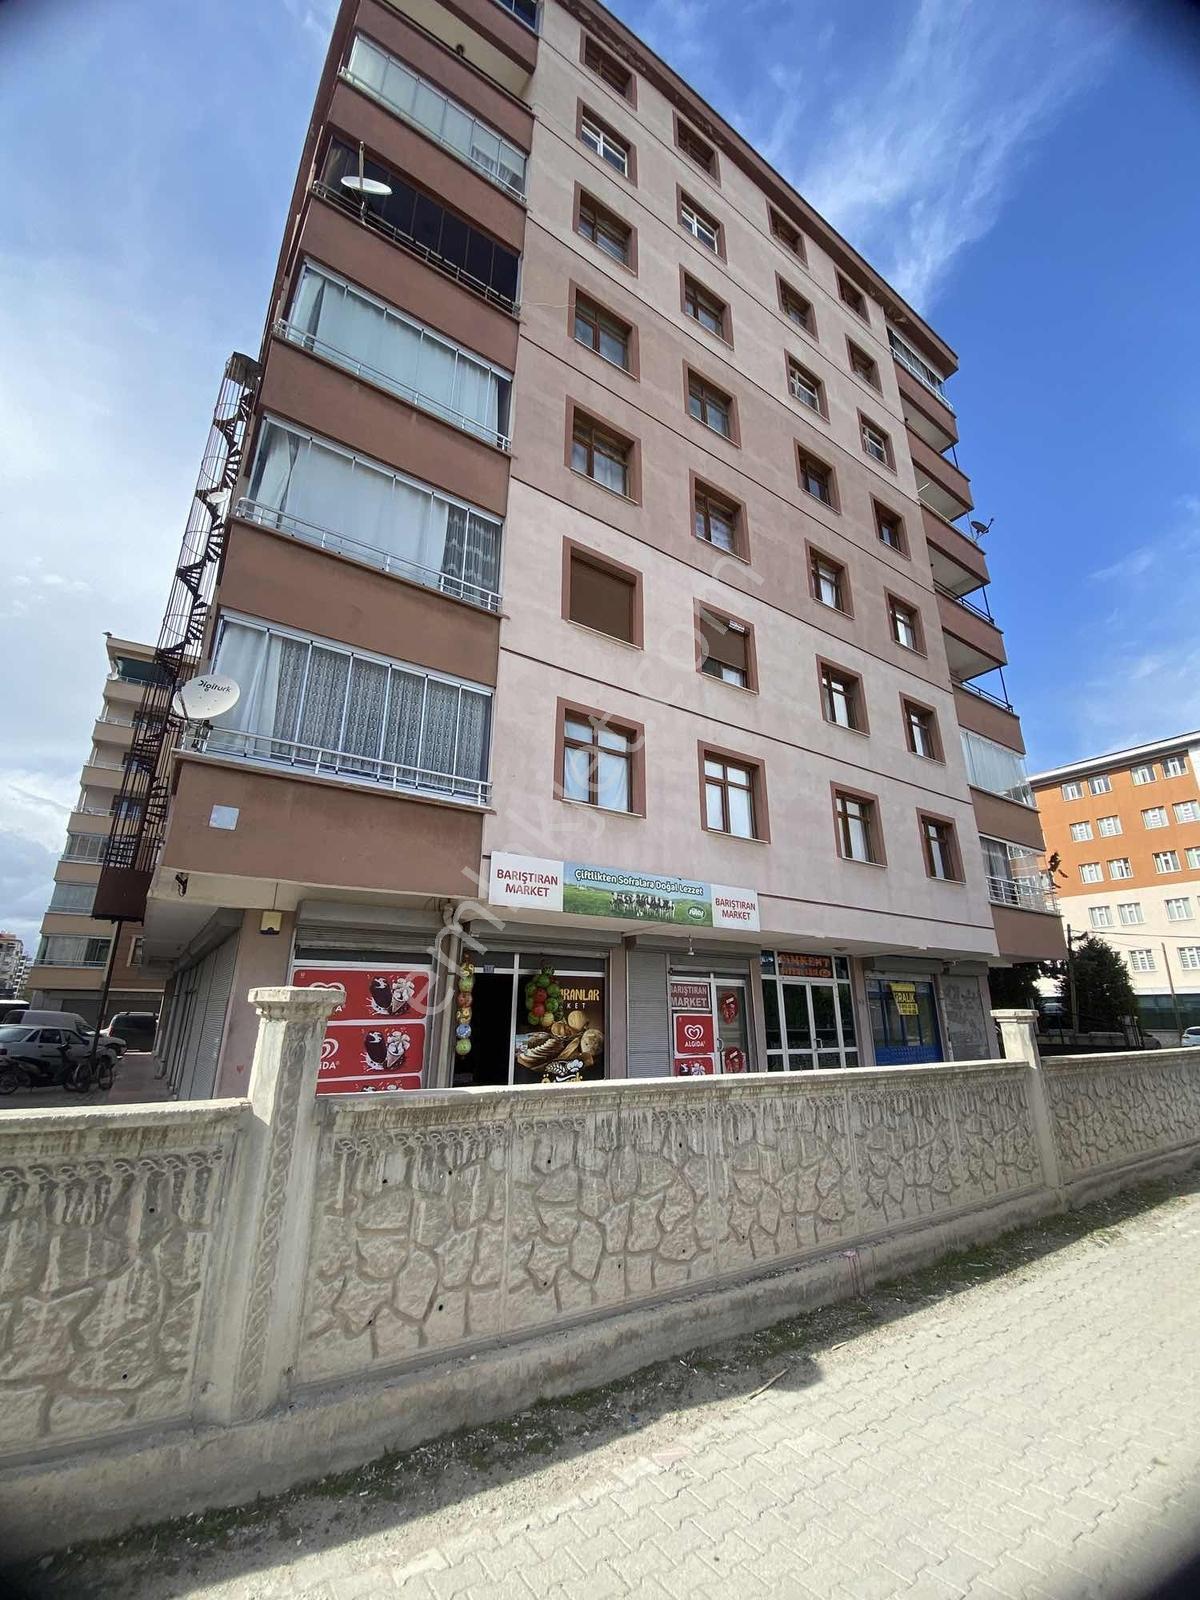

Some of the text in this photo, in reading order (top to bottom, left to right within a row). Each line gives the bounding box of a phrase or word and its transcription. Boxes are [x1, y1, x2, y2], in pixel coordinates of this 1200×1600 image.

[496, 868, 558, 886] BARIŞTIRAN
[574, 869, 704, 896] Çiftlikten Sofralara Doğal Lezzet
[505, 883, 550, 898] MARKET
[715, 897, 756, 911] BARIŞTIRAN
[721, 909, 751, 921] MARKET
